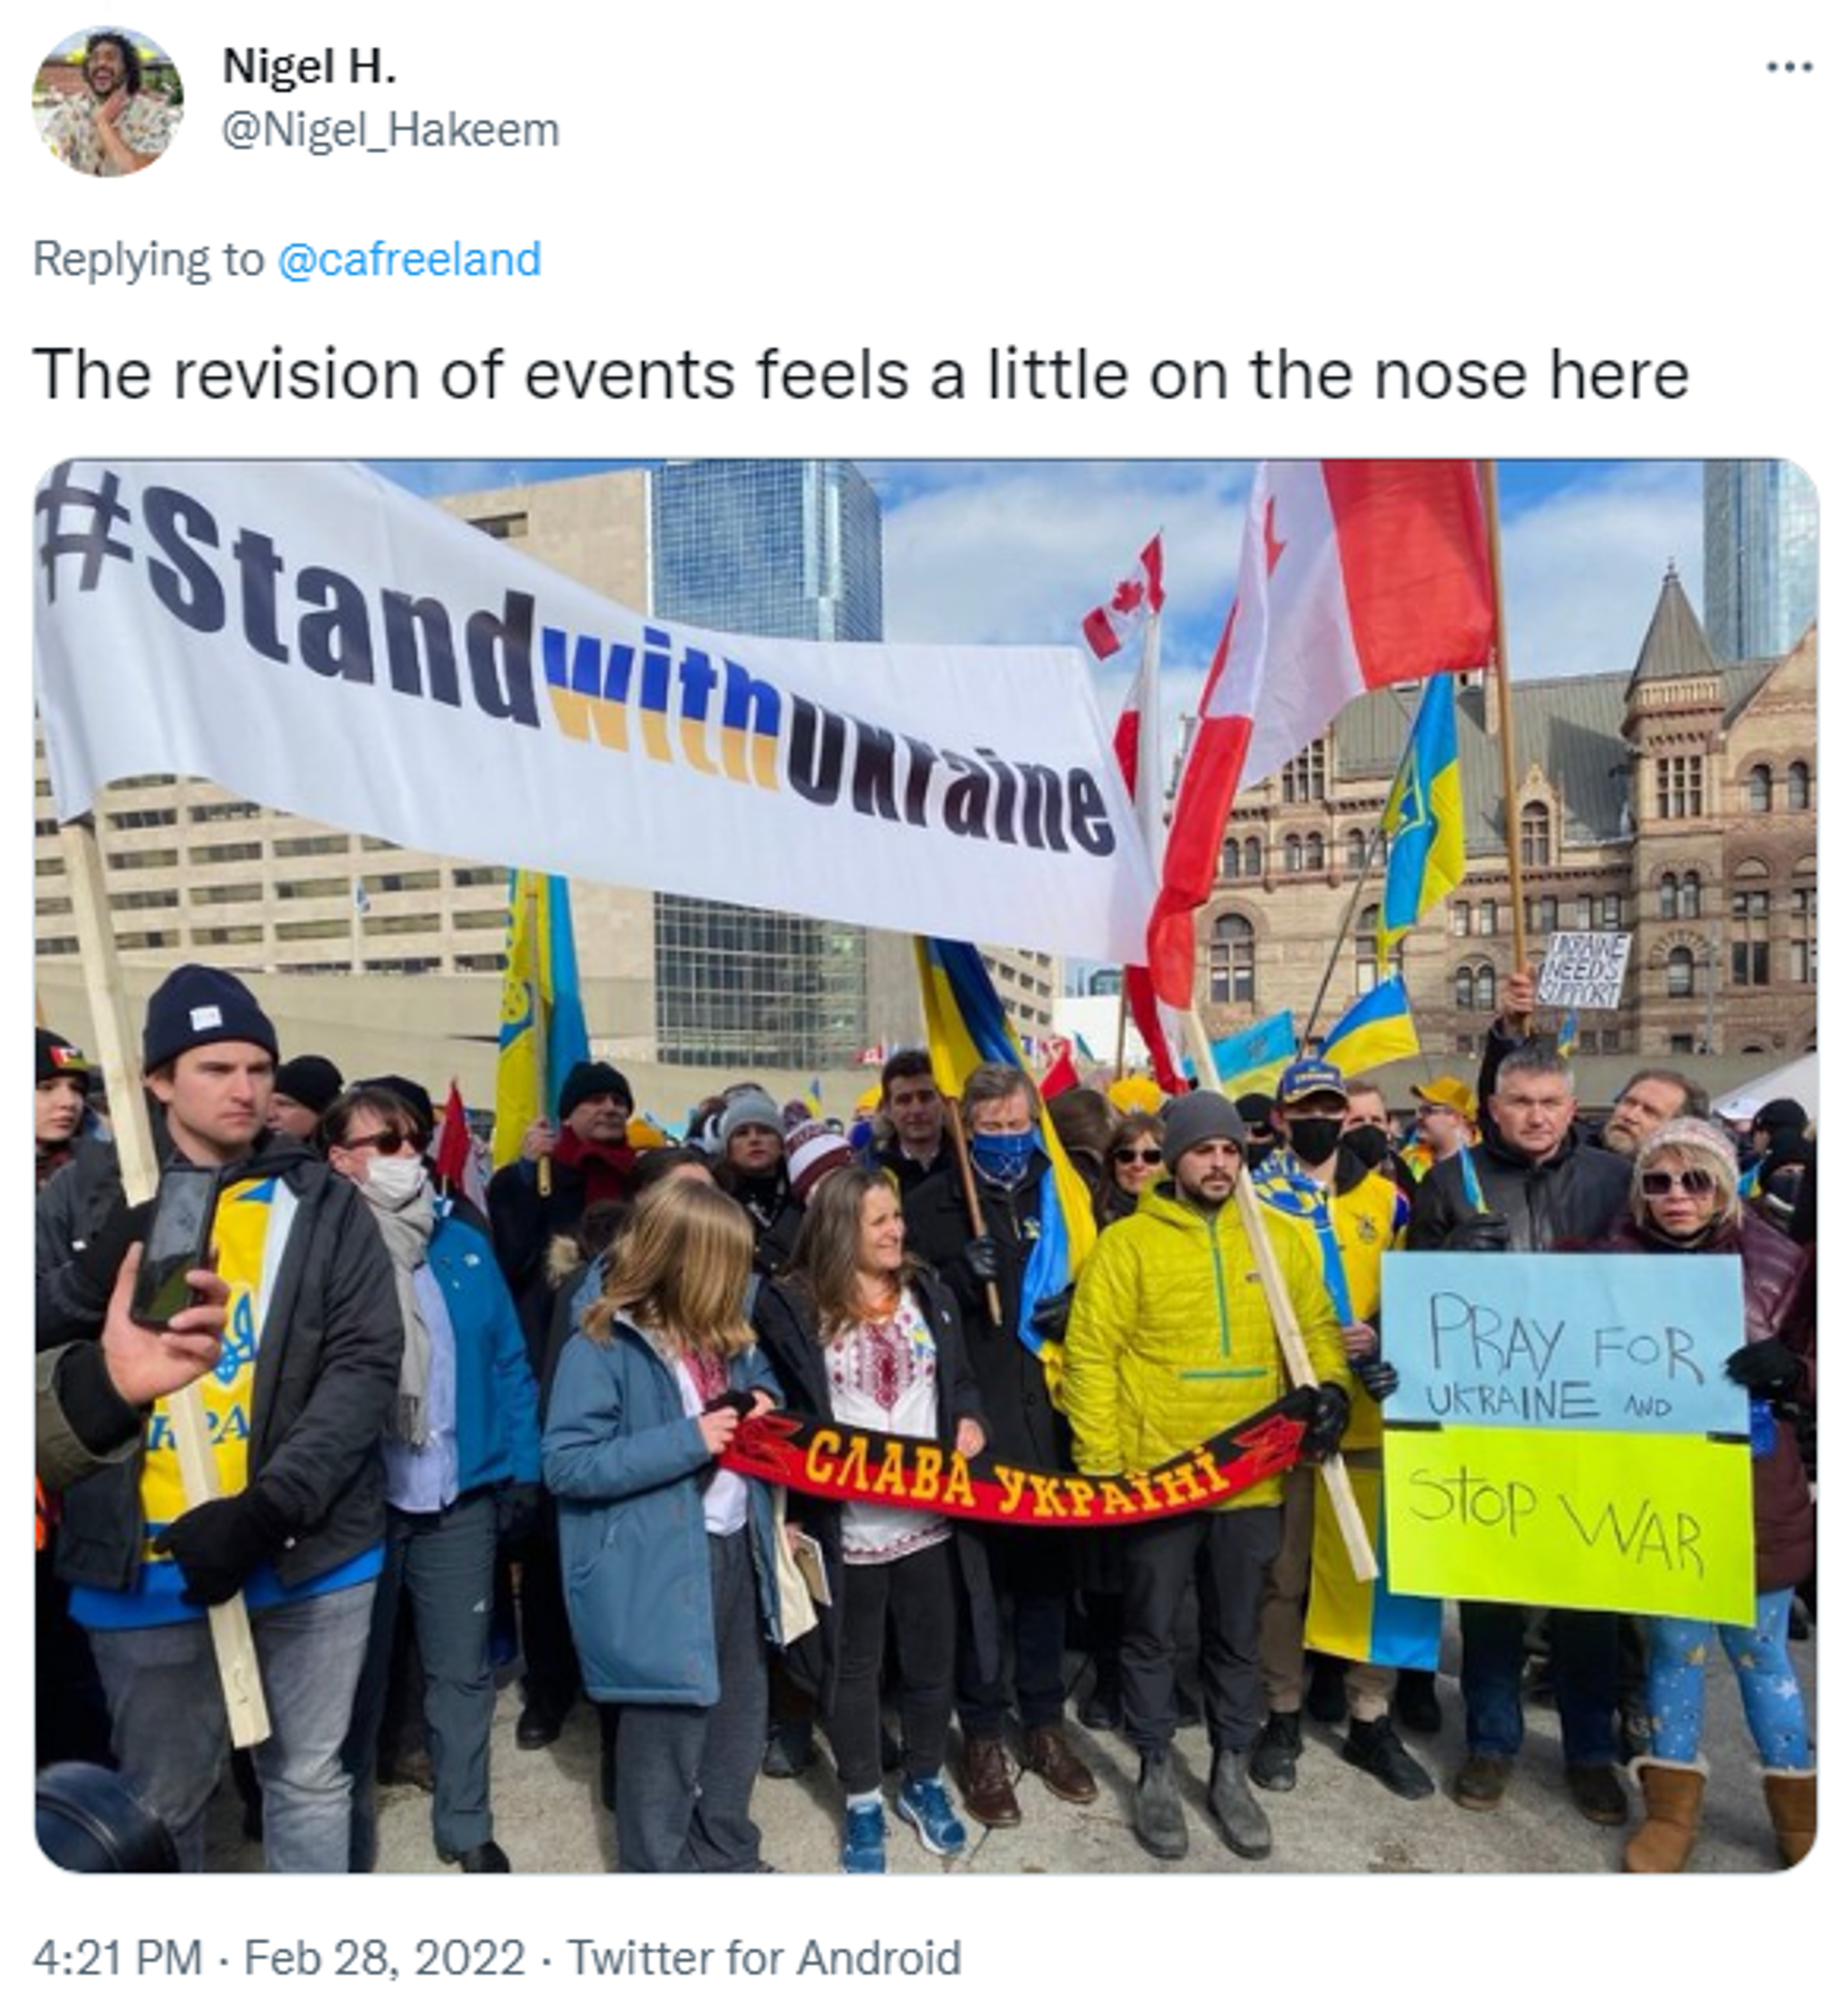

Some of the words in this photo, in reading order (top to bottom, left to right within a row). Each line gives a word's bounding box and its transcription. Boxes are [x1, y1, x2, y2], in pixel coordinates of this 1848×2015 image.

[1538, 979, 1619, 1004] SUPPORT
[1539, 960, 1619, 980] NEEDS
[1430, 1292, 1565, 1380] PRAY
[1594, 1326, 1704, 1386] FOR
[1425, 1381, 1600, 1421] UKRAINE
[1624, 1395, 1673, 1419] AND
[805, 1430, 976, 1507] СЛАВА
[1557, 1493, 1705, 1579] WAR
